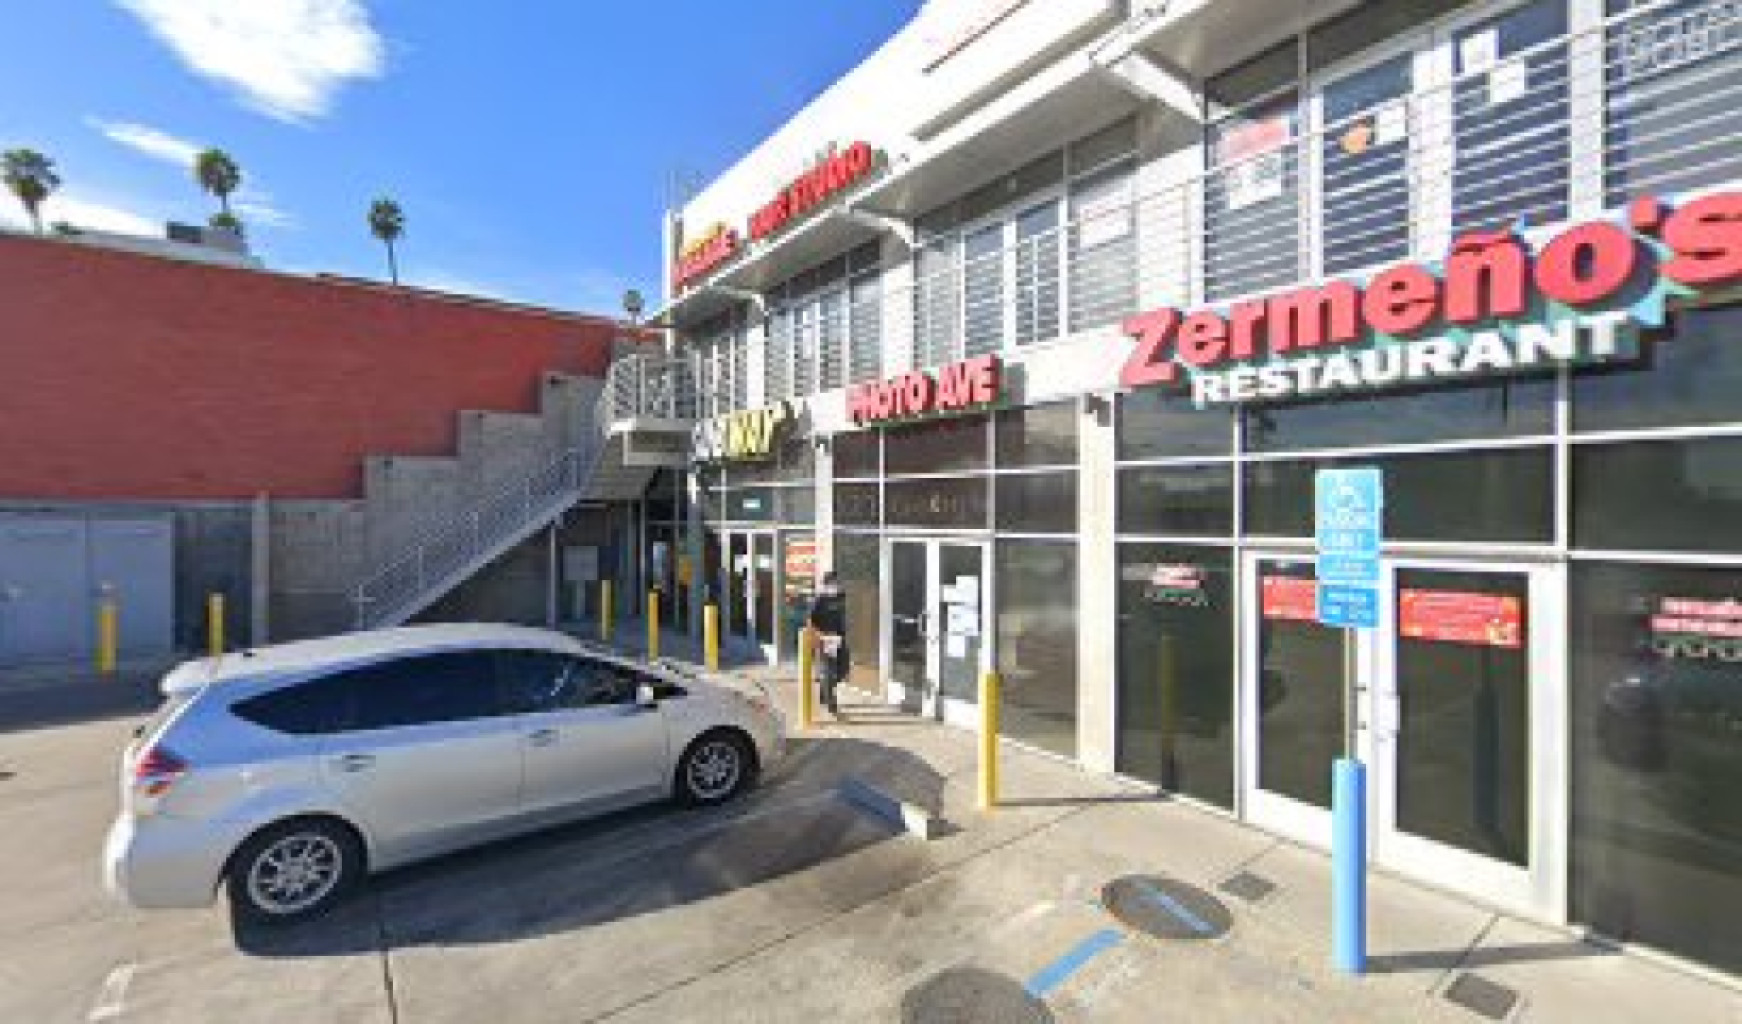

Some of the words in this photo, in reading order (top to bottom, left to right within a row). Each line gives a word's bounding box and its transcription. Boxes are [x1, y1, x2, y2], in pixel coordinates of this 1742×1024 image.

[1121, 190, 1742, 387] Zermeño's
[846, 368, 936, 426] PHOTO
[934, 353, 1001, 409] AVE
[1193, 310, 1630, 405] RESTAURANT
